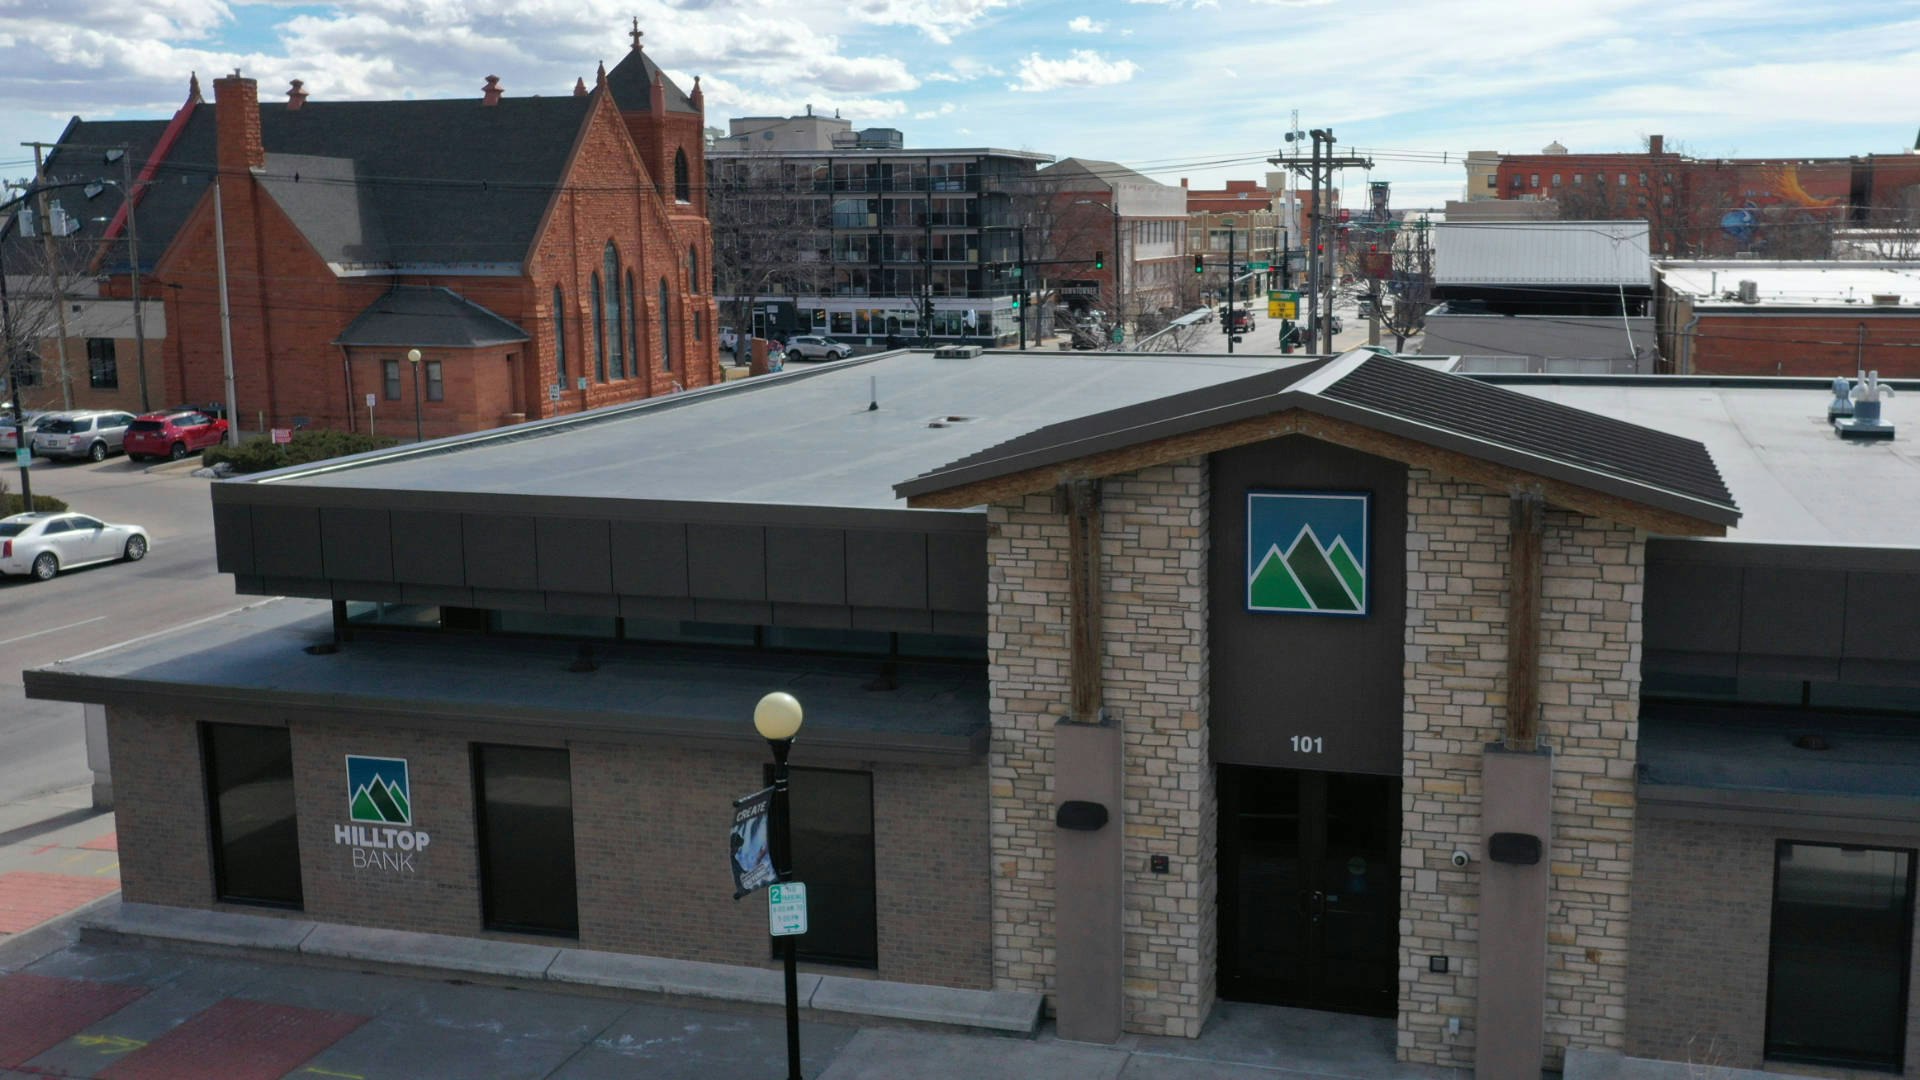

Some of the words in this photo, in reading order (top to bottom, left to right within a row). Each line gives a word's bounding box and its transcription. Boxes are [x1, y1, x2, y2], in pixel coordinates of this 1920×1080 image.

[1290, 735, 1323, 754] 101
[736, 800, 768, 823] CREATE
[334, 823, 431, 852] HILLTOP
[352, 848, 415, 873] BANK
[771, 888, 780, 902] 2
